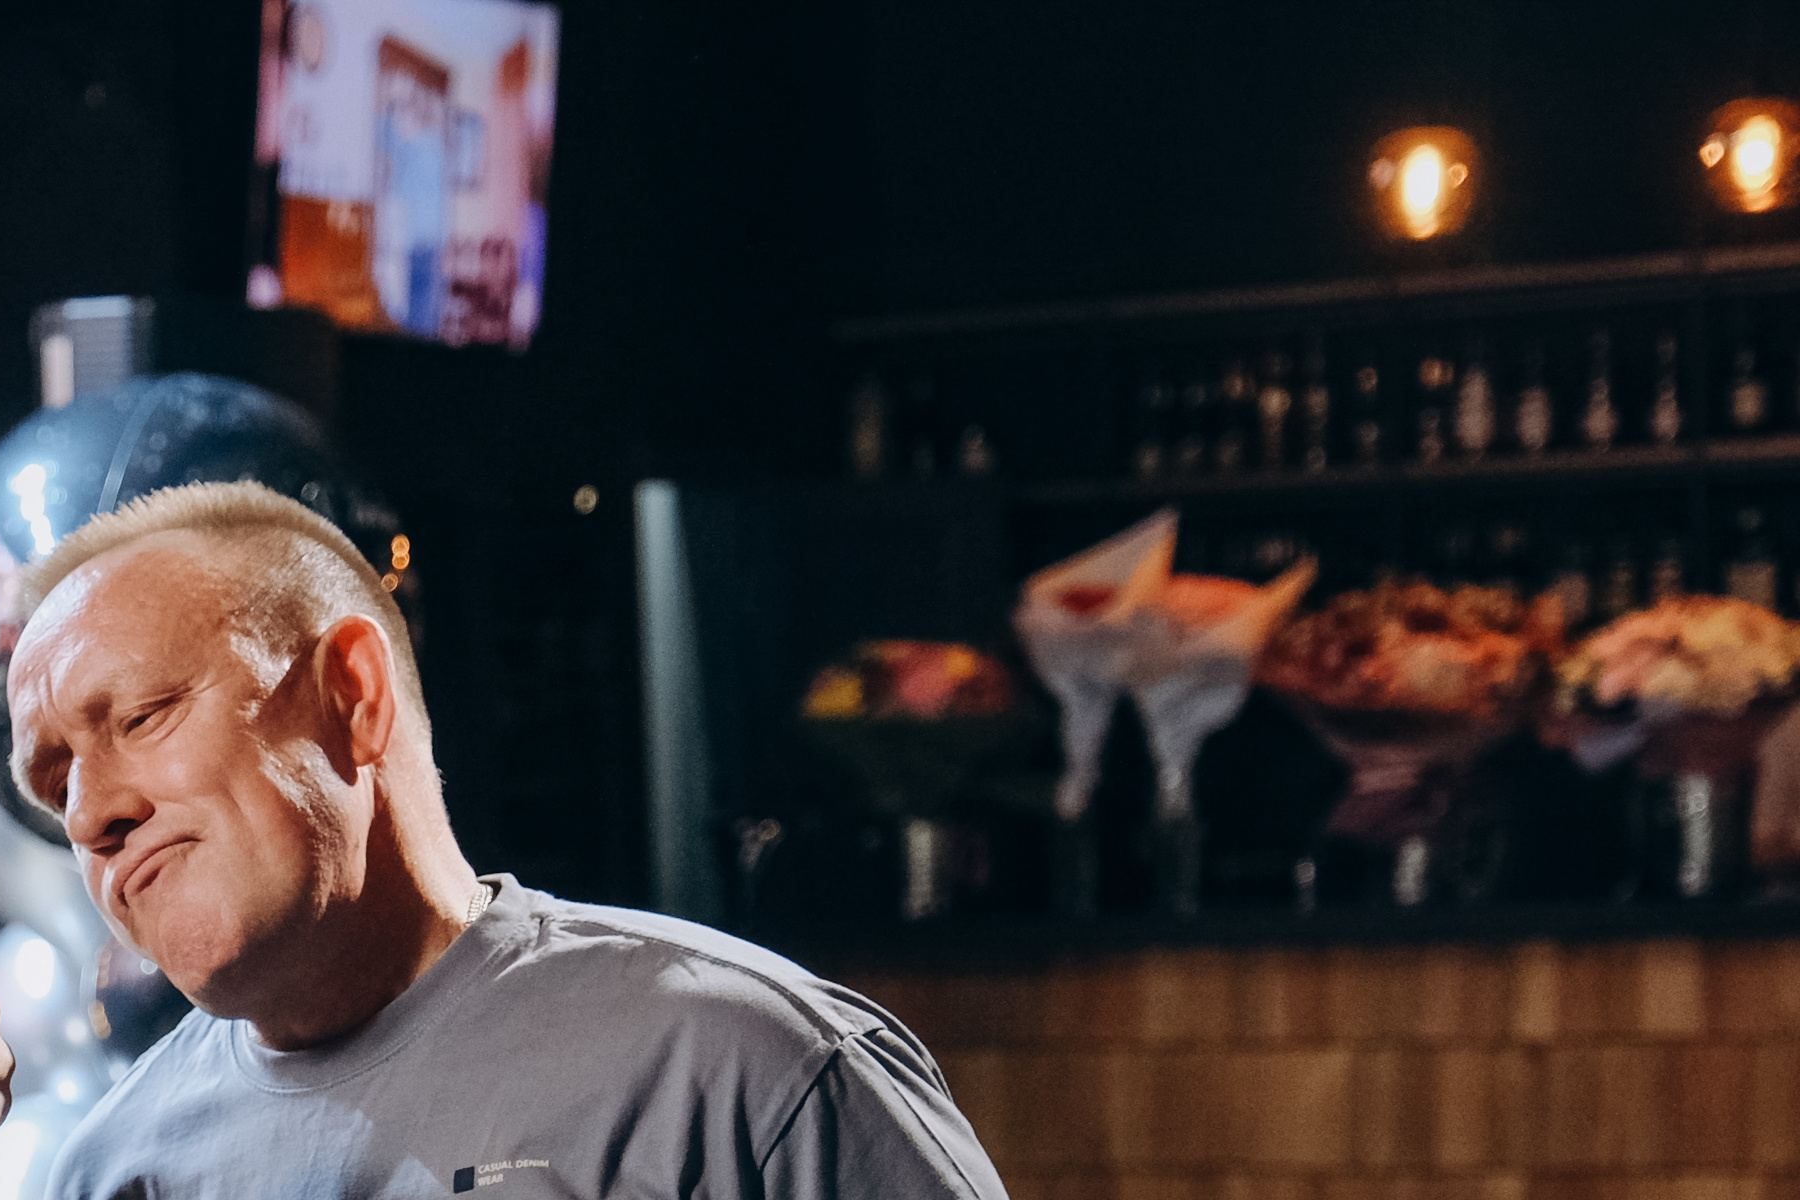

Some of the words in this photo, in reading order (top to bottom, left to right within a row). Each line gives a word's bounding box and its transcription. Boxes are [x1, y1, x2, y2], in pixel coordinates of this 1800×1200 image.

[477, 1160, 513, 1174] CASUAL
[515, 1159, 550, 1168] DENIM
[477, 1173, 504, 1187] WEAR
